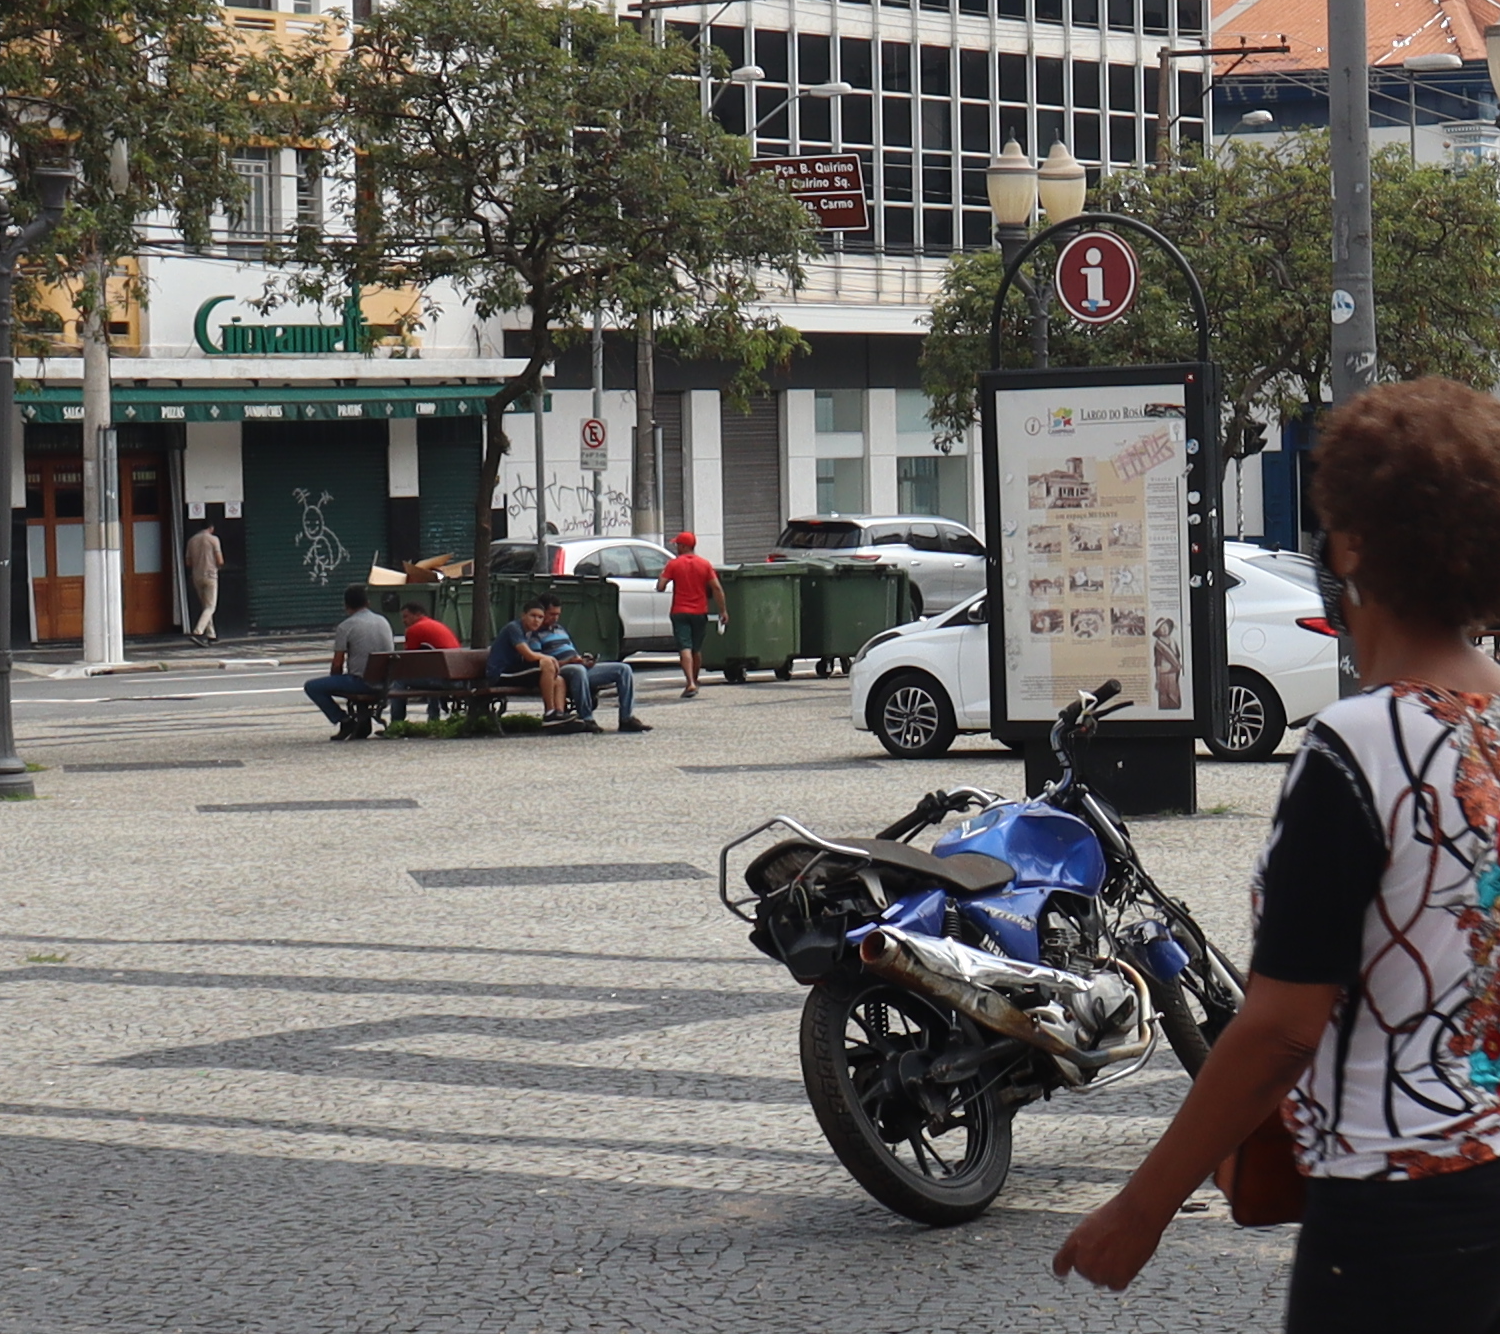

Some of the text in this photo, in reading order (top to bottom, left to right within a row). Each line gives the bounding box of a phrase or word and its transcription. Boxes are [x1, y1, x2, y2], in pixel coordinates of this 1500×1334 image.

[774, 161, 854, 176] Pça. B. Quirino
[834, 175, 851, 189] Sq.
[820, 198, 854, 210] Carmo
[1108, 408, 1121, 420] DO
